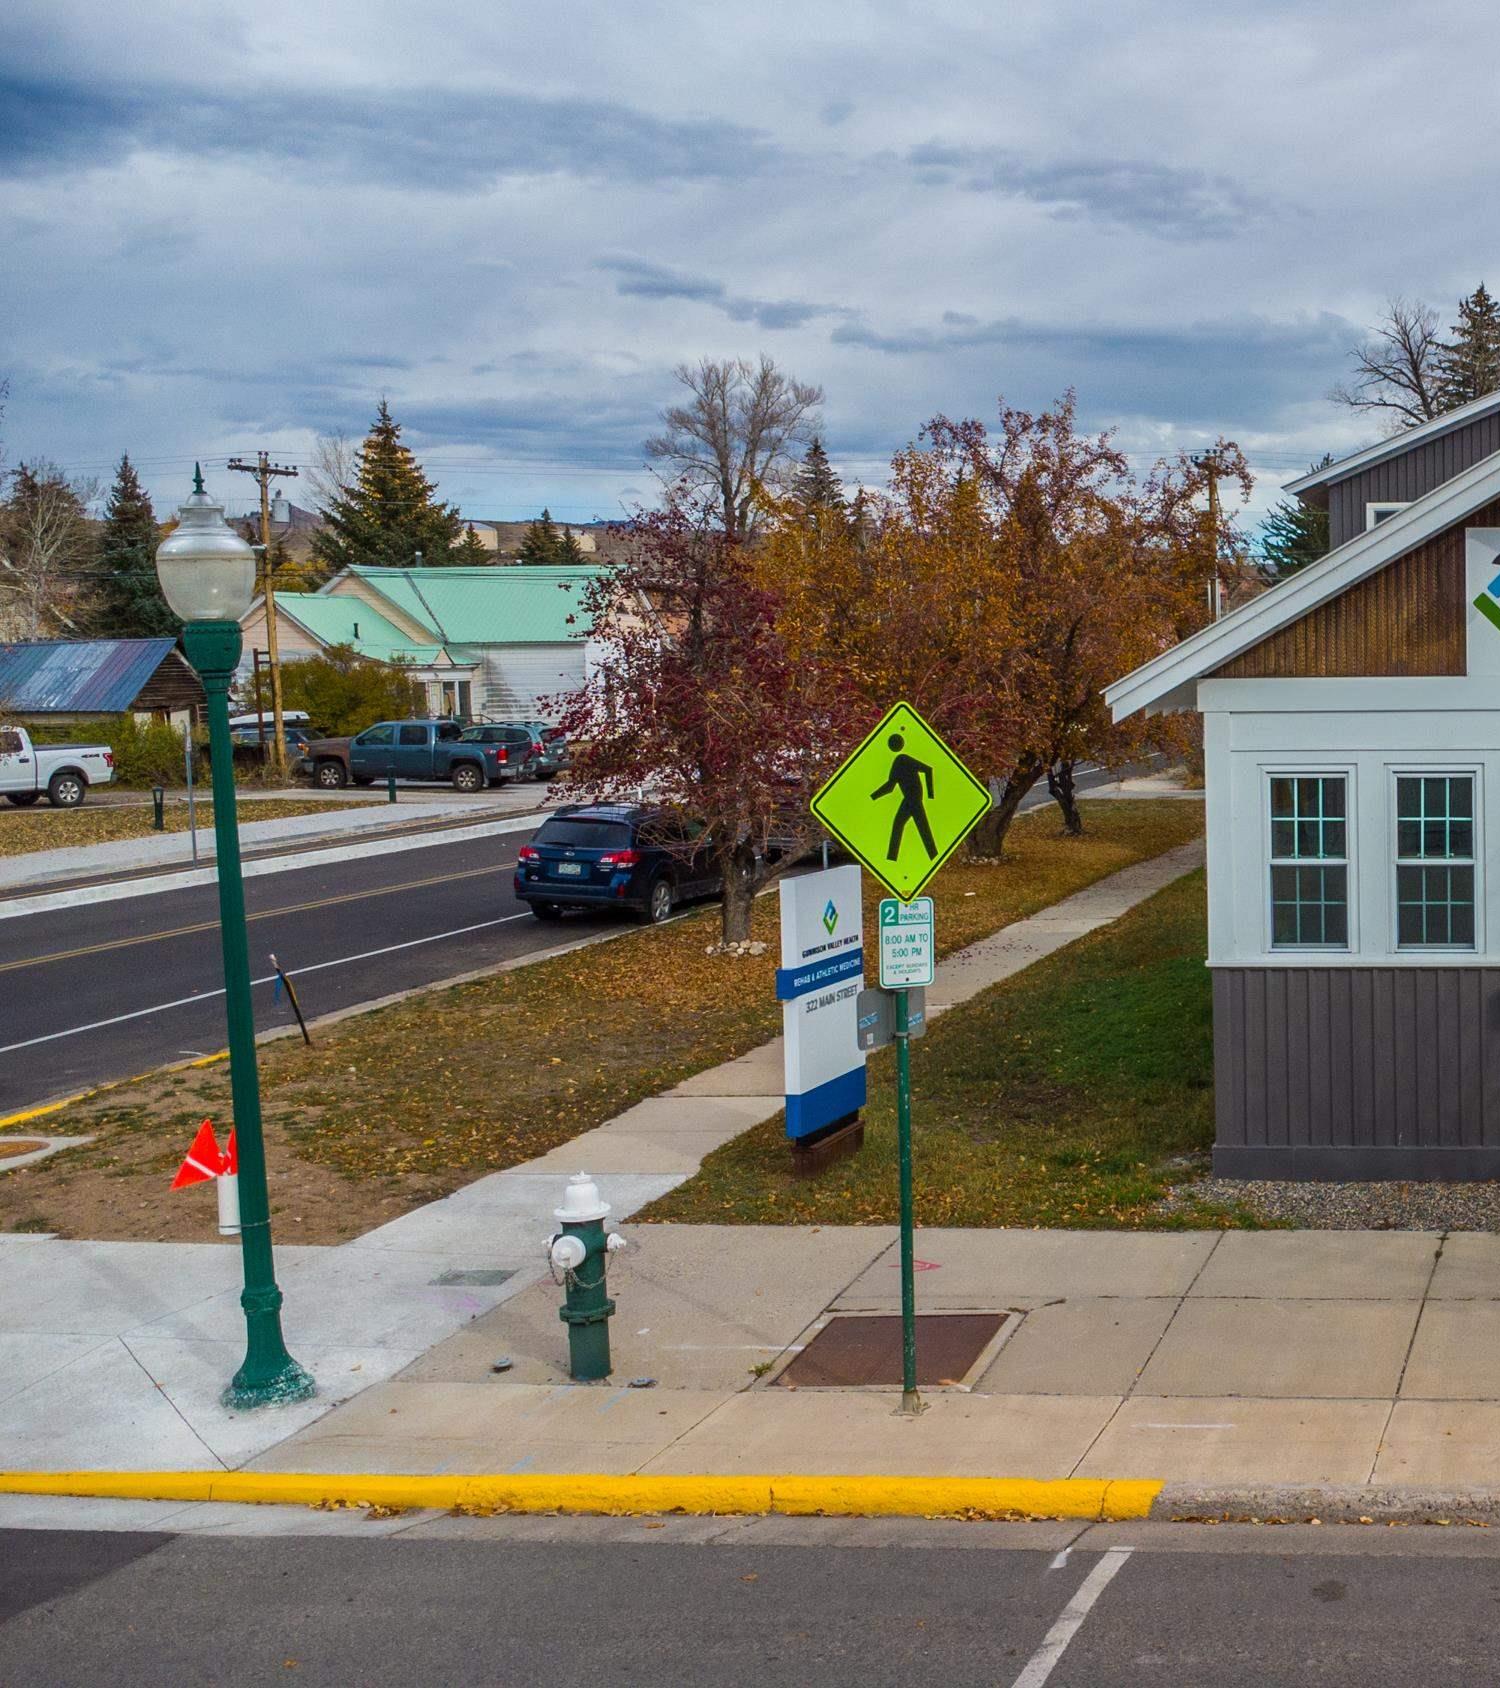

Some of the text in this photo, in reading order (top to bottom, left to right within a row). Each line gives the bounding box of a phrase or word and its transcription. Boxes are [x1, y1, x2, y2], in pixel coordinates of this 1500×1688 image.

[909, 903, 919, 911] HR
[884, 906, 896, 923] 2
[900, 912, 929, 921] PARKING
[827, 939, 843, 950] VALLEY
[885, 933, 929, 945] 8:00 AM TO
[891, 947, 922, 958] 5:00 PM
[793, 974, 811, 987] REHAB
[816, 965, 839, 980] ATHLETIC
[839, 957, 861, 972] MEDICINE
[805, 984, 858, 1013] 322 MAIN STREET
